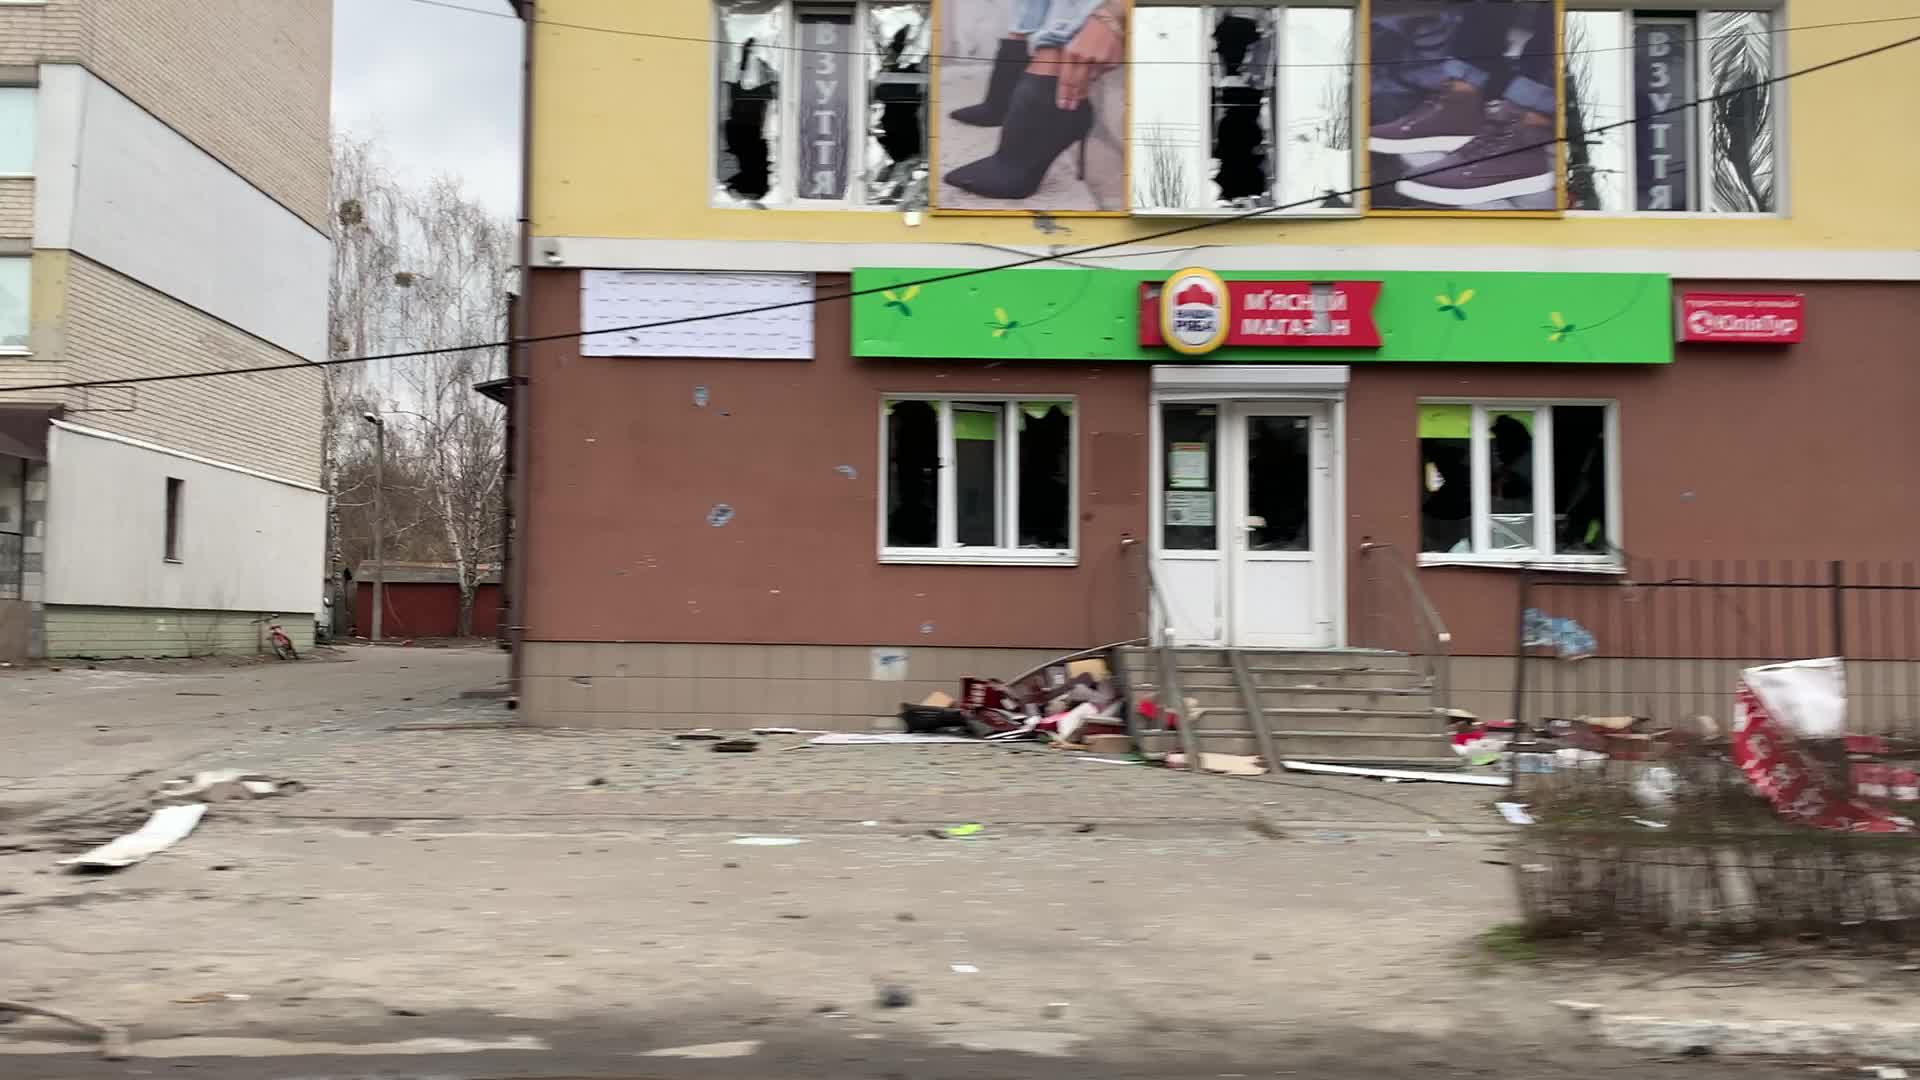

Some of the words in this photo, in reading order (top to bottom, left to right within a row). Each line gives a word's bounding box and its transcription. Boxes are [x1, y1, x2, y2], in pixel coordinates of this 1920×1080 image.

[813, 21, 838, 195] ВЗУТТЯ
[1648, 31, 1673, 210] ВЗУТТЯ
[1240, 319, 1351, 336] МАГАЗН
[1243, 290, 1348, 311] М'ЯСНЙ
